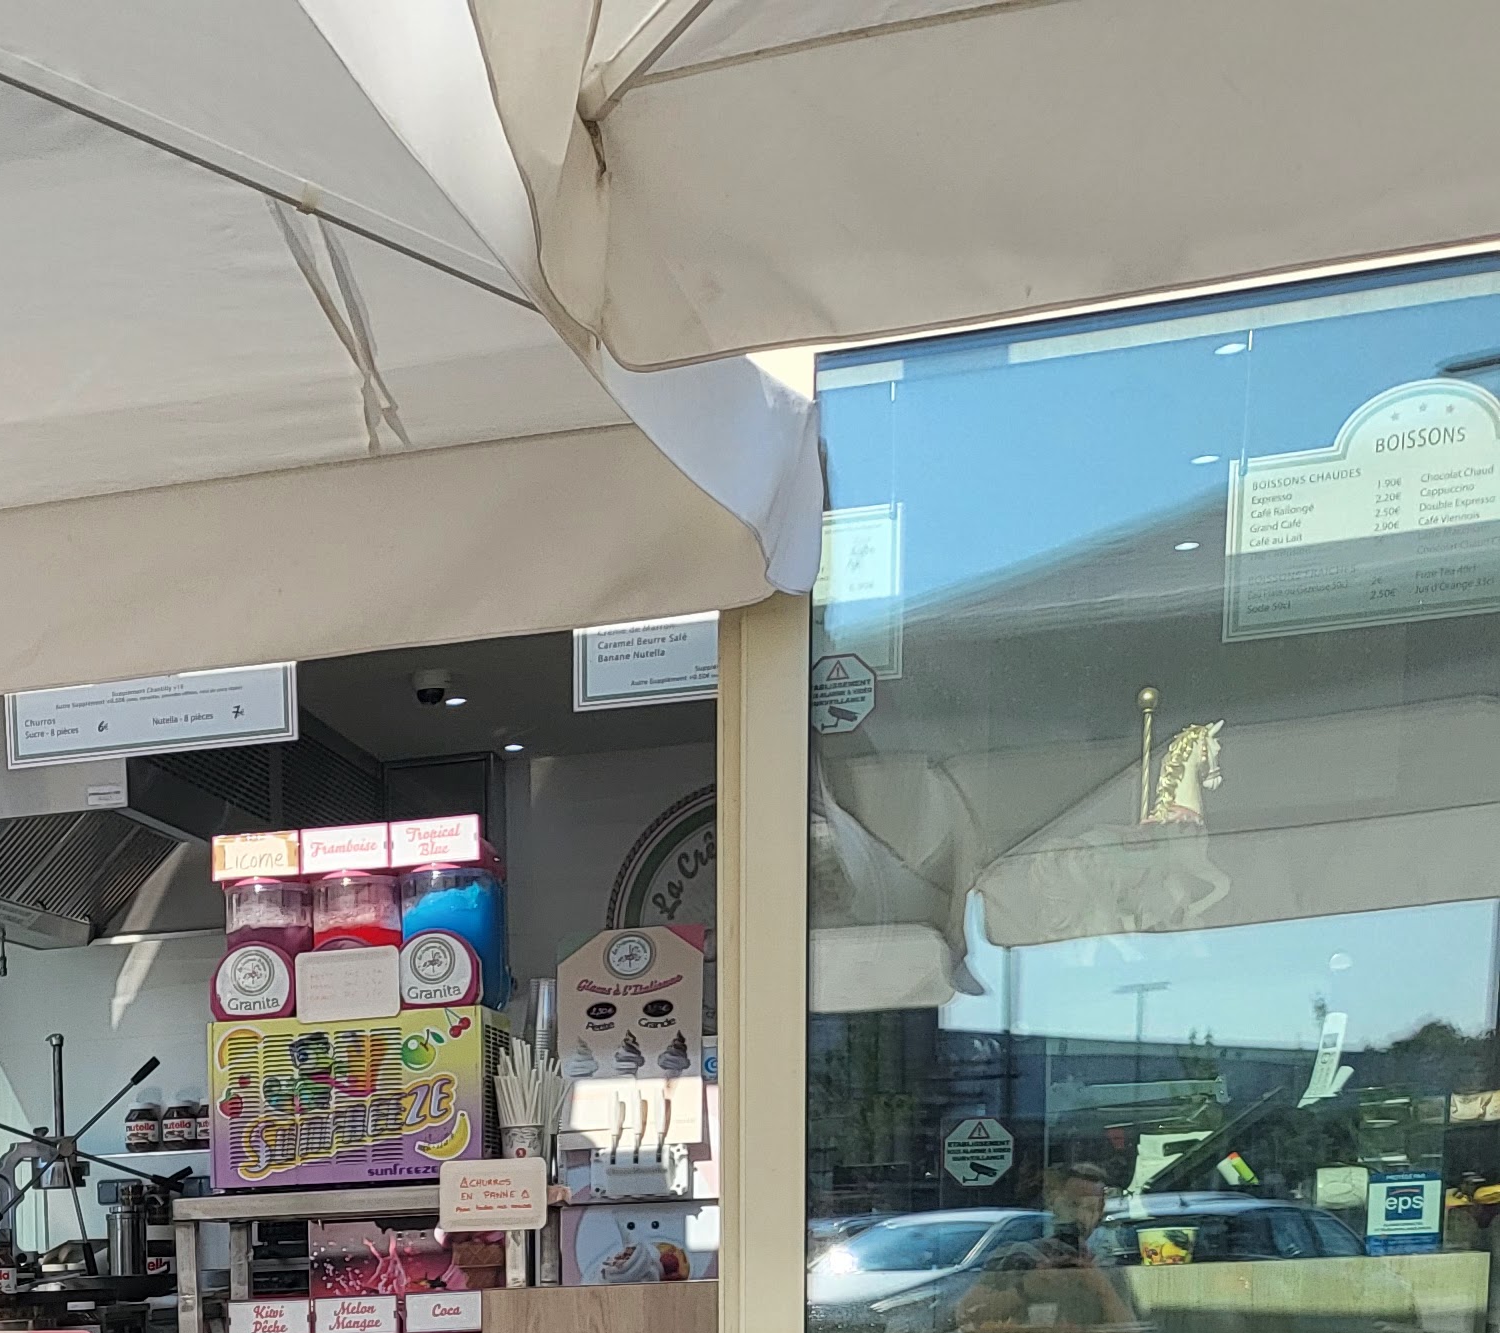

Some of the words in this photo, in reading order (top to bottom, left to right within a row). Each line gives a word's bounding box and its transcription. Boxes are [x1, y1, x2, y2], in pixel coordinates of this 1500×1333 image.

[1375, 426, 1467, 453] BOISSONS
[1252, 473, 1306, 491] BOISSONS
[1309, 467, 1362, 484] CHAUDES
[1420, 469, 1463, 484] Chocolat
[1463, 464, 1495, 478] Chaud
[1251, 492, 1293, 505] Expresso
[1420, 484, 1476, 498] Cappuccino
[1250, 507, 1272, 519] Café
[1419, 499, 1454, 512] Double
[1249, 522, 1279, 534] Grand
[1280, 518, 1302, 531] Café
[1249, 536, 1270, 548] Café
[1270, 535, 1284, 546] au
[598, 638, 634, 650] Caramel
[636, 634, 666, 646] Beurre
[668, 632, 688, 643] Salé
[598, 650, 631, 663] Banane
[633, 648, 666, 659] Nutella
[24, 716, 56, 728] Churros
[152, 715, 179, 726] Nutella
[190, 711, 214, 723] pièces
[24, 729, 45, 740] Sucre
[56, 725, 80, 738] pièces
[405, 823, 461, 844] Tropical
[309, 840, 378, 858] Framboise
[417, 840, 450, 857] Blue
[652, 879, 684, 921] La
[677, 831, 716, 879] Crê
[407, 983, 462, 1000] Granita
[227, 996, 281, 1012] Granita
[638, 1018, 677, 1028] Grande
[125, 1122, 156, 1133] nutella
[163, 1120, 192, 1130] nutella
[461, 1192, 473, 1200] EN
[483, 1190, 516, 1199] PANNE
[1385, 1195, 1424, 1214] eps
[253, 1304, 285, 1319] Kiwi
[334, 1302, 377, 1316] Melon
[431, 1303, 462, 1318] Coca
[328, 1314, 382, 1332] Mangue
